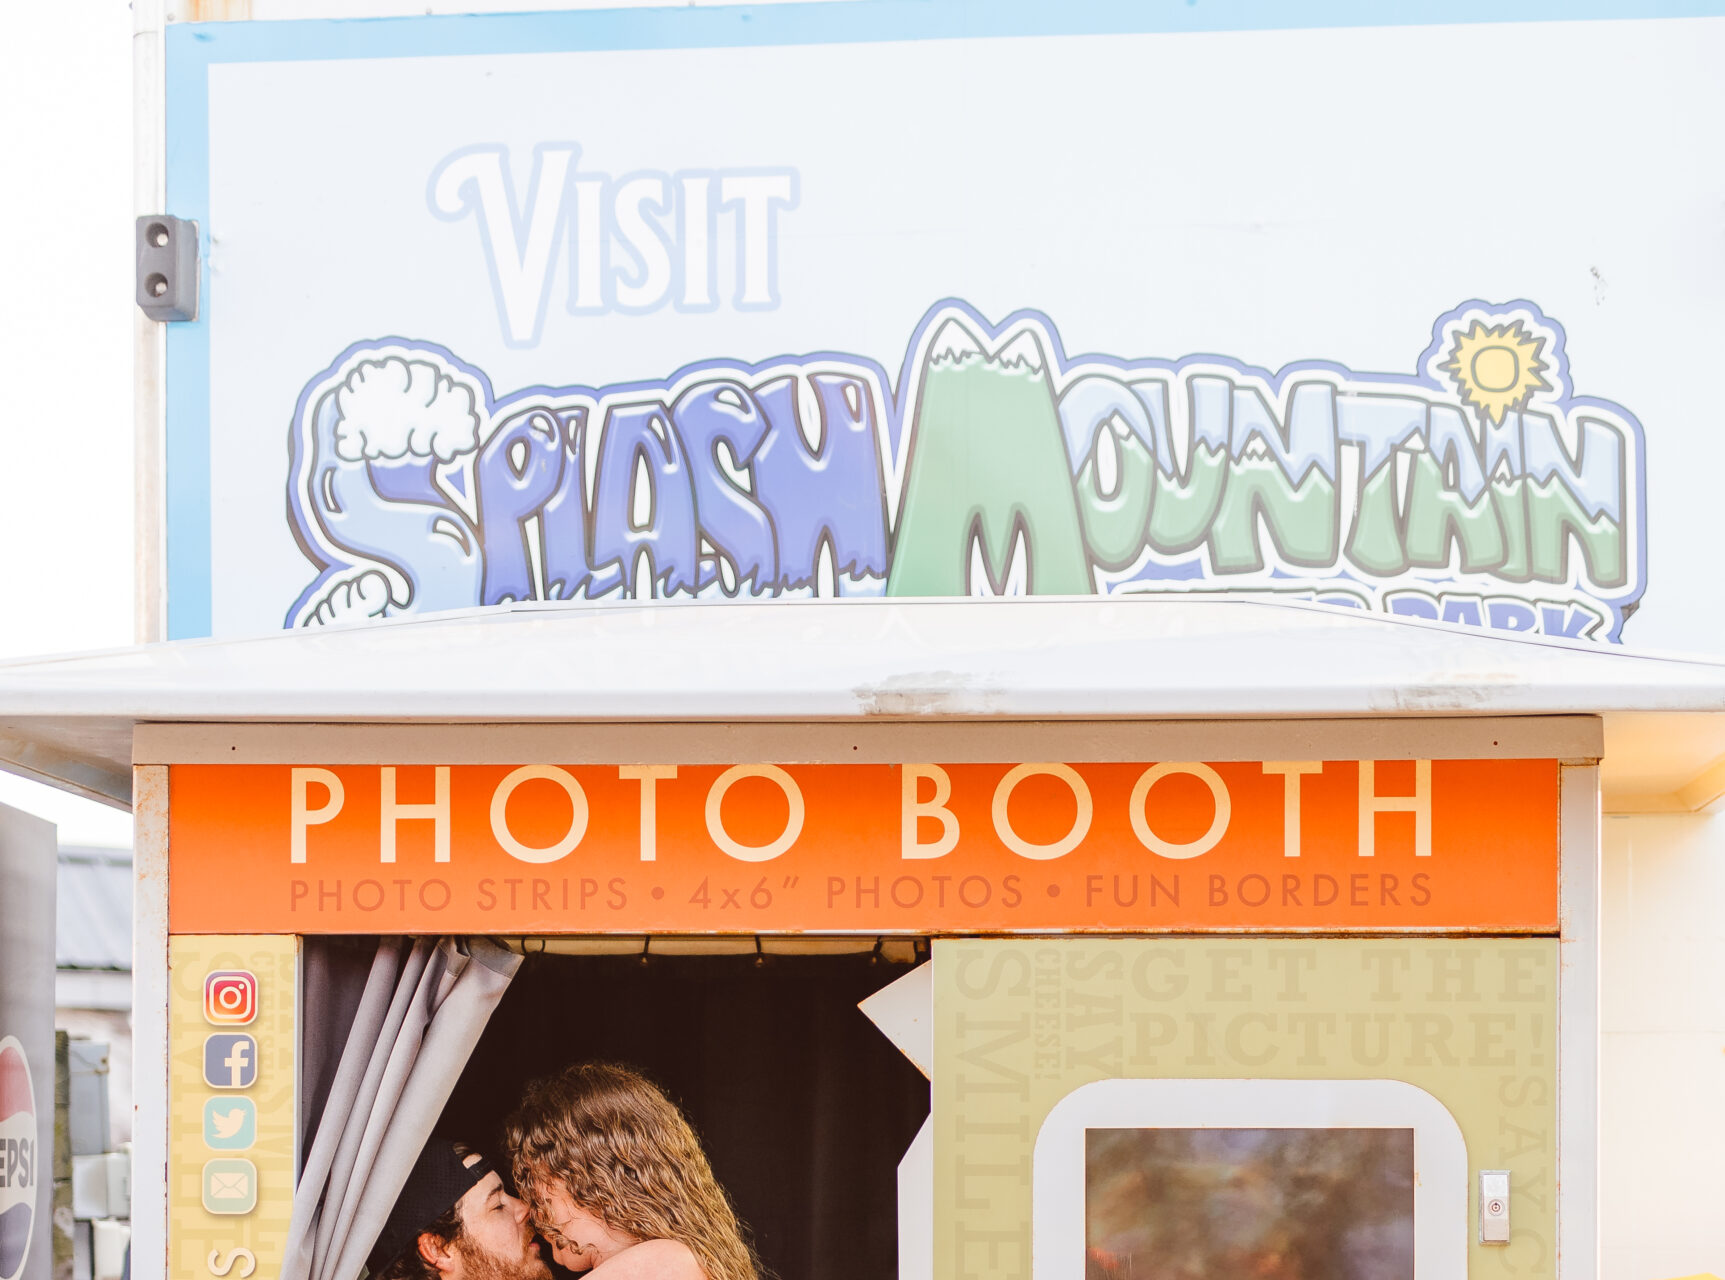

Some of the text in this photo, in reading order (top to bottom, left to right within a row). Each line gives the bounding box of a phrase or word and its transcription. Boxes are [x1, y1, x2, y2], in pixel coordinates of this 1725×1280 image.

[291, 760, 1432, 864] PHOTO BOOTH
[291, 878, 452, 912] PHOTO
[477, 876, 627, 912] STRIPS
[826, 874, 1022, 909] PHOTOS
[1086, 873, 1180, 908] FUN
[1209, 872, 1433, 907] BORDERS
[1131, 947, 1548, 1002] GET THE
[1129, 1012, 1546, 1068] PICTURE!
